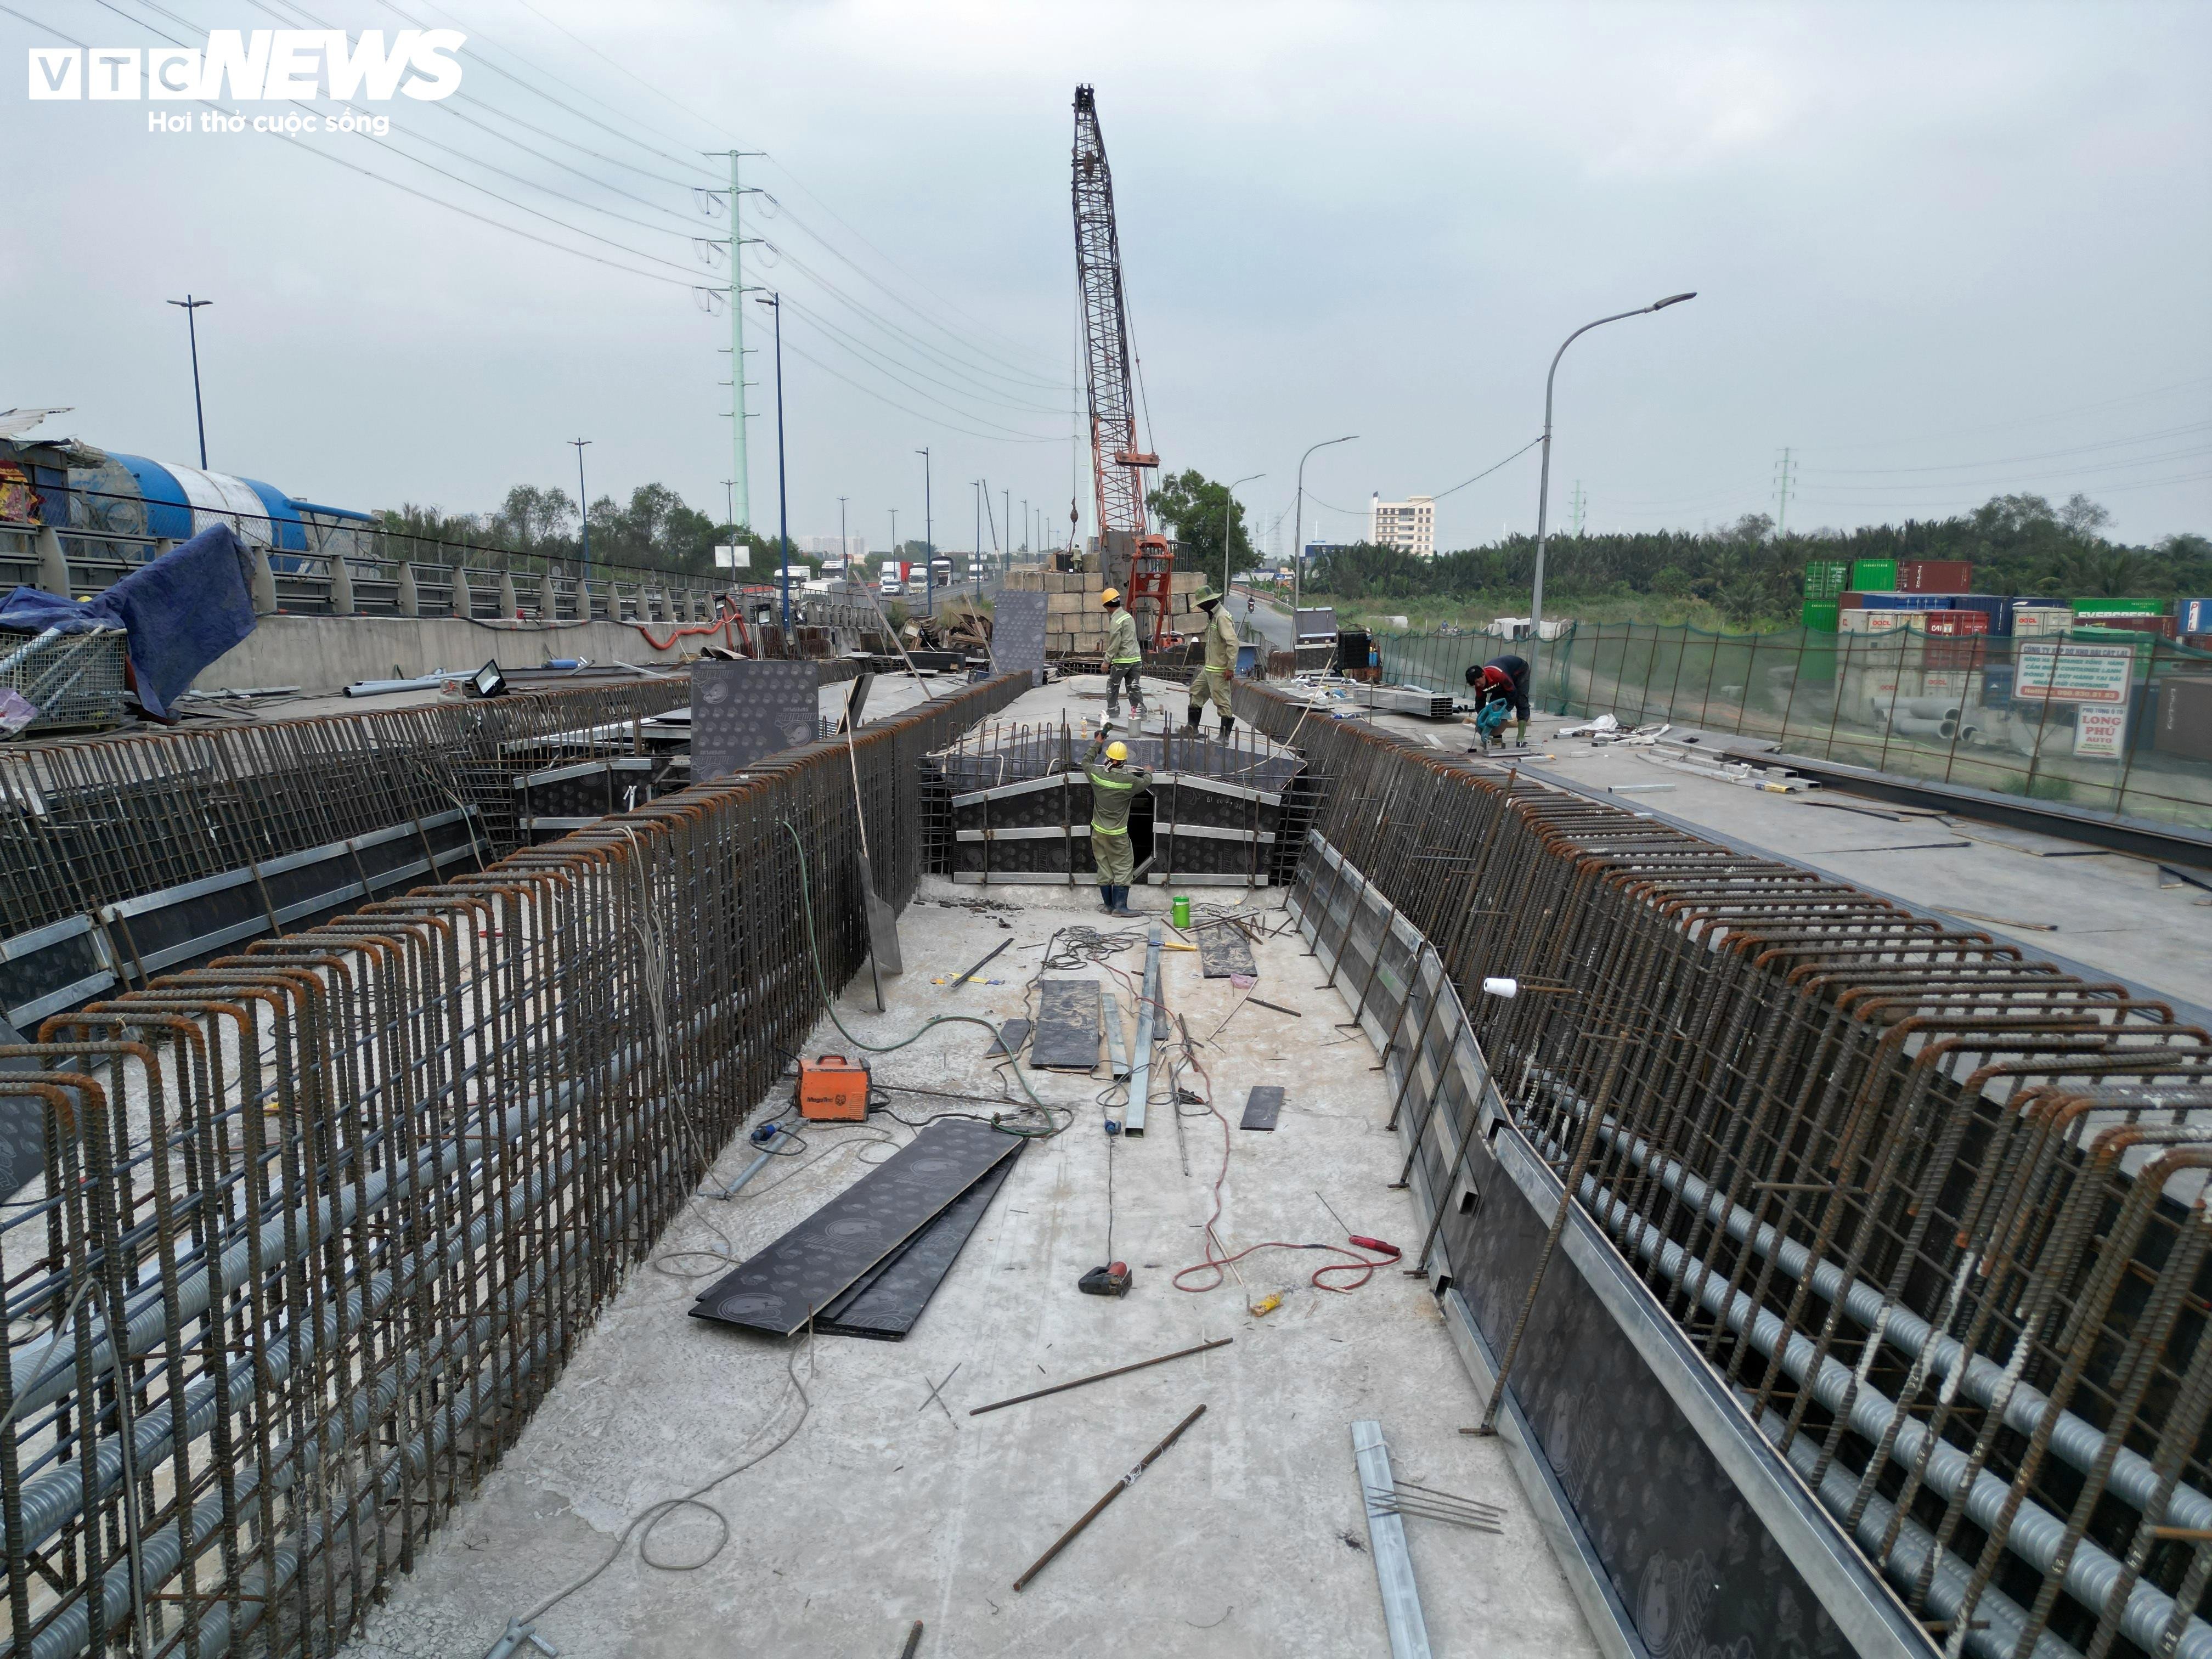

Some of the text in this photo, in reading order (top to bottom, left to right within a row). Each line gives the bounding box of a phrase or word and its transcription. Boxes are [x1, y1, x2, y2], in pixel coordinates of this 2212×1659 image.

[2188, 602, 2198, 630] PIL
[2083, 716, 2121, 725] LONG
[2086, 725, 2116, 736] PHÚ
